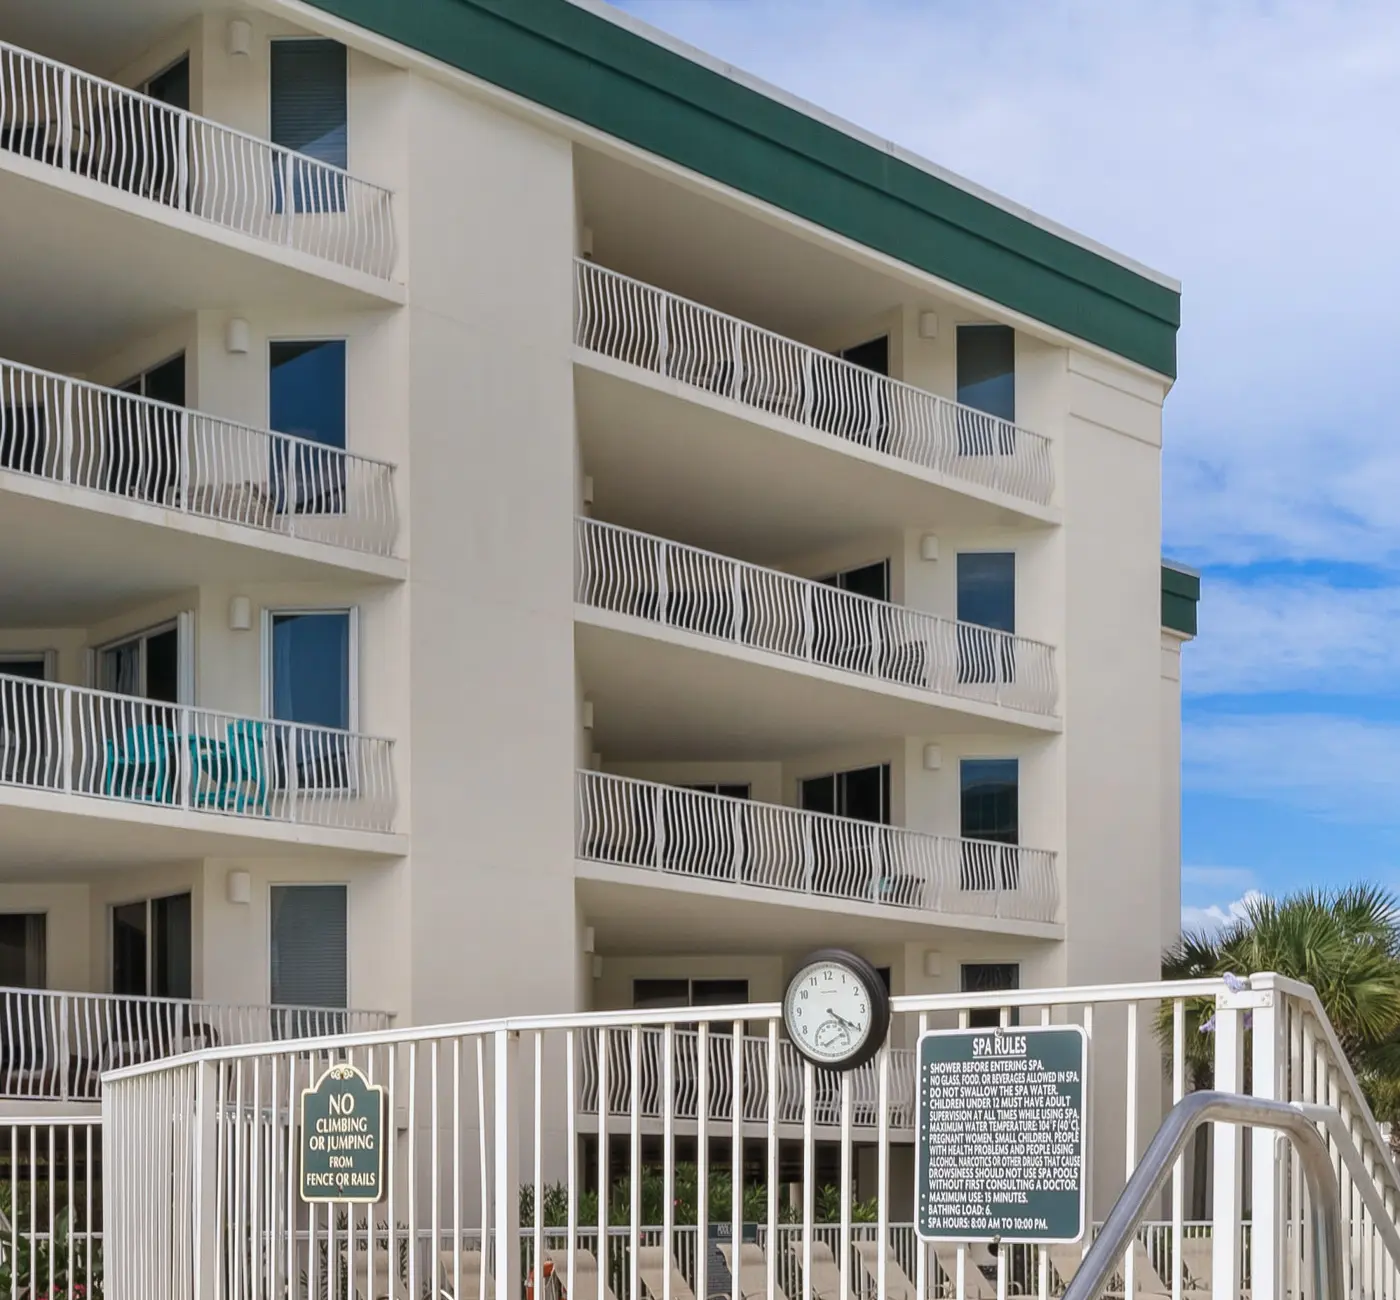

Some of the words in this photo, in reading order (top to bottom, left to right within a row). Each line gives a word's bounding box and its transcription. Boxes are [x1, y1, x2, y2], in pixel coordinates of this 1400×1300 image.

[823, 971, 833, 980] 12
[842, 974, 845, 984] 1
[809, 977, 817, 986] 11
[800, 990, 808, 999] 10
[853, 986, 859, 996] 2
[797, 1007, 802, 1017] 9
[860, 1004, 865, 1013] 3
[803, 1025, 807, 1034] 8
[857, 1023, 861, 1032] 4
[973, 1037, 992, 1055] SPA
[995, 1036, 1026, 1054] RULES
[930, 1062, 961, 1073] SHOWER
[963, 1062, 989, 1072] BEFORE
[991, 1061, 1027, 1071] ENTERING
[1029, 1060, 1044, 1070] SPA.
[930, 1074, 940, 1085] NO
[962, 1073, 980, 1084] FOOD,
[982, 1073, 991, 1084] OR
[992, 1072, 1025, 1084] BEVERAGES
[1026, 1072, 1056, 1083] ALLOWED
[1058, 1072, 1065, 1082] IN
[1066, 1072, 1079, 1082] SPA.
[930, 1087, 941, 1097] DO
[943, 1087, 959, 1097] NOT
[960, 1086, 998, 1097] SWALLOW
[999, 1086, 1014, 1096] THE
[1015, 1085, 1028, 1095] SPA
[1029, 1085, 1058, 1095] WATER.
[329, 1094, 354, 1115] NO
[930, 1098, 964, 1109] CHILDREN
[966, 1098, 991, 1108] UNDER
[993, 1097, 1000, 1108] 12
[1001, 1097, 1022, 1108] MUST
[1024, 1097, 1044, 1107] HAVE
[1045, 1096, 1071, 1107] ADULT
[930, 1110, 972, 1121] SUPERVISION
[974, 1110, 982, 1120] AT
[984, 1110, 995, 1120] ALL
[997, 1109, 1017, 1120] TIMES
[1018, 1109, 1040, 1120] WHILE
[1041, 1109, 1063, 1119] USING
[1065, 1109, 1079, 1119] SPA.
[316, 1117, 367, 1133] CLIMBING
[930, 1121, 963, 1132] MAXIMUM
[964, 1121, 987, 1131] WATER
[989, 1120, 1038, 1131] TEMPERATURE:
[930, 1133, 963, 1143] PREGNANT
[995, 1133, 1016, 1143] SMALL
[1055, 1132, 1079, 1142] PEOPLE
[310, 1136, 325, 1150] OR
[327, 1135, 373, 1152] JUMPING
[929, 1145, 947, 1155] WITH
[948, 1145, 973, 1155] HEALTH
[974, 1145, 1008, 1155] PROBLEMS
[1010, 1144, 1025, 1154] AND
[1026, 1144, 1050, 1154] PEOPLE
[1051, 1144, 1073, 1154] USING
[330, 1156, 352, 1168] FROM
[959, 1156, 992, 1166] NARCOTICS
[993, 1156, 1000, 1166] OR
[1002, 1156, 1021, 1166] OTHER
[1023, 1156, 1043, 1166] DRUGS
[1044, 1156, 1060, 1166] THAT
[1061, 1156, 1080, 1166] CAUSE
[929, 1168, 973, 1178] DROWSINESS
[975, 1168, 1004, 1178] SHOULD
[1006, 1168, 1022, 1178] NOT
[1024, 1168, 1036, 1178] USE
[1038, 1168, 1051, 1178] SPA
[1053, 1168, 1078, 1178] POOLS
[307, 1173, 333, 1186] FENCE
[336, 1174, 349, 1186] OR
[352, 1173, 375, 1186] RAILS
[929, 1180, 964, 1190] WITHOUT
[966, 1180, 984, 1190] FIRST
[986, 1180, 1034, 1190] CONSULTING
[1036, 1180, 1041, 1190] A
[1043, 1180, 1078, 1190] DOCTOR.
[929, 1192, 966, 1202] MAXIMUM
[968, 1192, 983, 1202] USE:
[985, 1192, 991, 1202] 15
[993, 1192, 1028, 1203] MINUTES.
[929, 1205, 961, 1215] BATHING
[962, 1205, 984, 1215] LOAD:
[985, 1206, 992, 1215] 6.
[928, 1218, 942, 1228] SPA
[943, 1218, 970, 1228] HOURS:
[971, 1218, 986, 1228] 8:00
[988, 1218, 1000, 1229] AM
[1002, 1218, 1013, 1229] TO
[1014, 1218, 1034, 1229] 10:00
[1034, 1218, 1048, 1229] PM.
